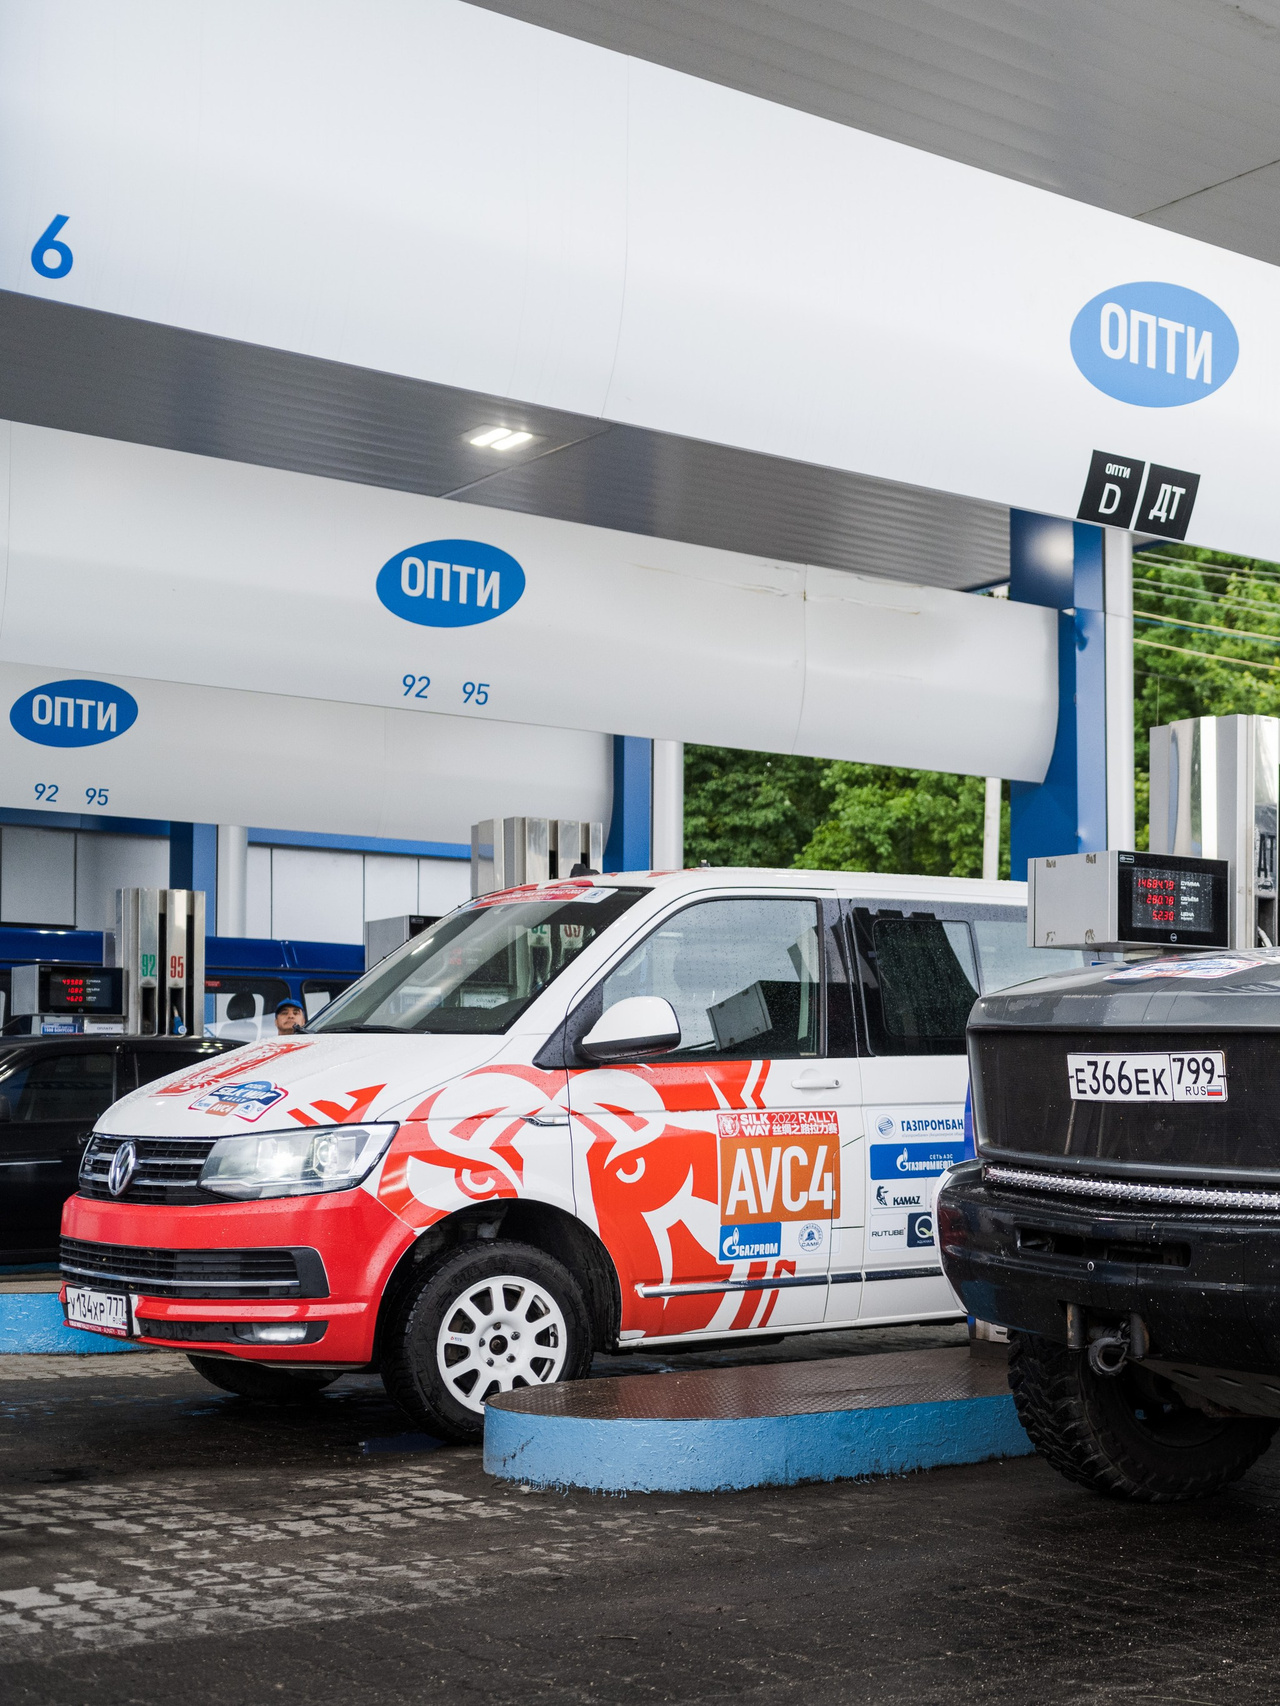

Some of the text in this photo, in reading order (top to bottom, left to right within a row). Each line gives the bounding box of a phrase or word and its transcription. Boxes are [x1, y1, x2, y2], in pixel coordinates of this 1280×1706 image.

[31, 214, 73, 279] 6
[1099, 302, 1213, 385] ОПТИ
[1105, 462, 1131, 479] ОПТИ
[1098, 482, 1122, 515] D
[1148, 483, 1186, 523] ДТ
[400, 556, 500, 609] ОПТИ
[402, 674, 490, 705] 92 95
[32, 694, 117, 732] ОПТИ
[34, 782, 110, 806] 92 95
[141, 954, 157, 977] 92
[169, 955, 184, 979] 95
[1172, 1057, 1215, 1085] 799
[1185, 1086, 1206, 1096] RUS
[740, 1111, 836, 1125] SILK 2022 RALLY
[741, 1124, 770, 1136] WAY
[725, 1145, 836, 1216] AVC4
[893, 1195, 921, 1206] KAMAZ
[871, 1229, 905, 1237] RUTUBE
[738, 1242, 779, 1257] GAZPROM
[106, 1296, 124, 1317] 777
